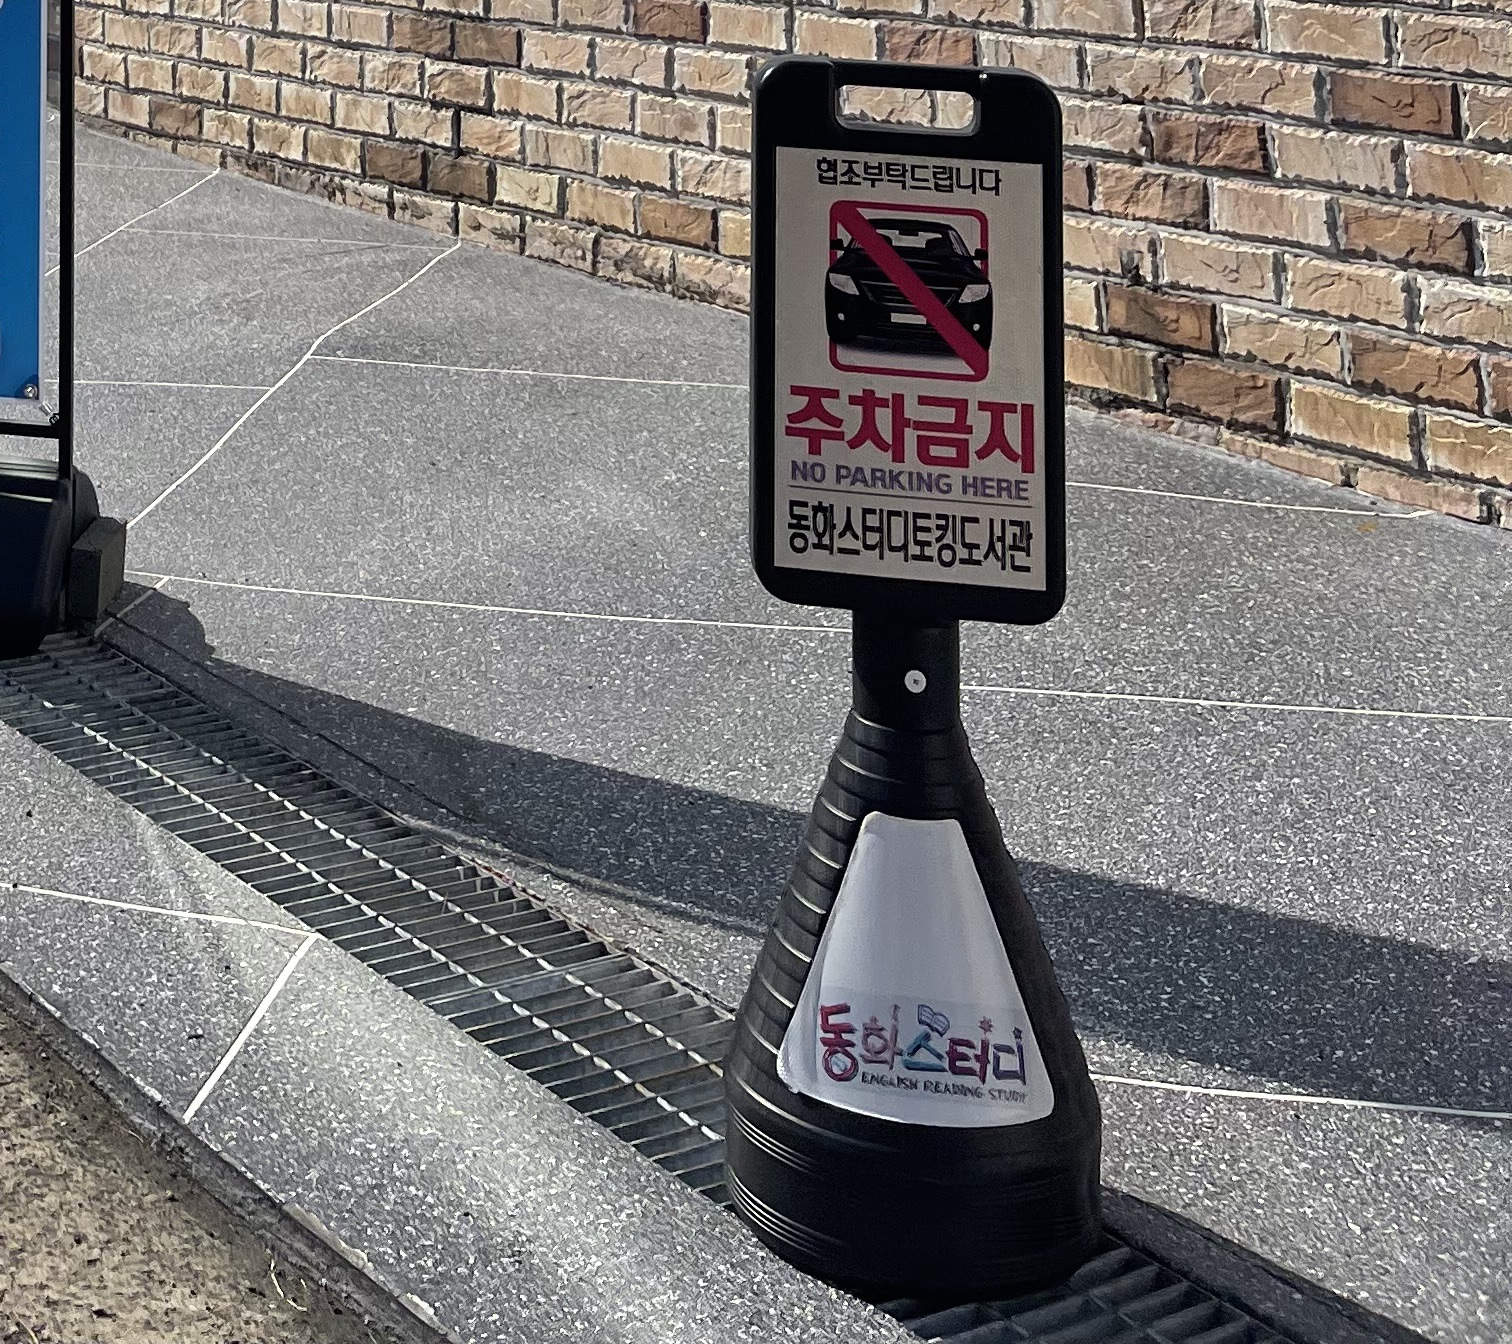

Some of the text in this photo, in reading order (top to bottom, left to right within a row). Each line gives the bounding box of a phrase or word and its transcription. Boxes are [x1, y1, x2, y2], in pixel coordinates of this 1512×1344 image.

[816, 156, 1002, 197] 협조부탁드립니다
[784, 384, 1036, 475] 주차금지
[790, 461, 1030, 502] NO PARKING HERE
[787, 498, 1034, 573] 동화스터디토킹도서관
[819, 1002, 1027, 1086] 동화스터디
[861, 1071, 1029, 1103] ENGLISH READING STUDY
